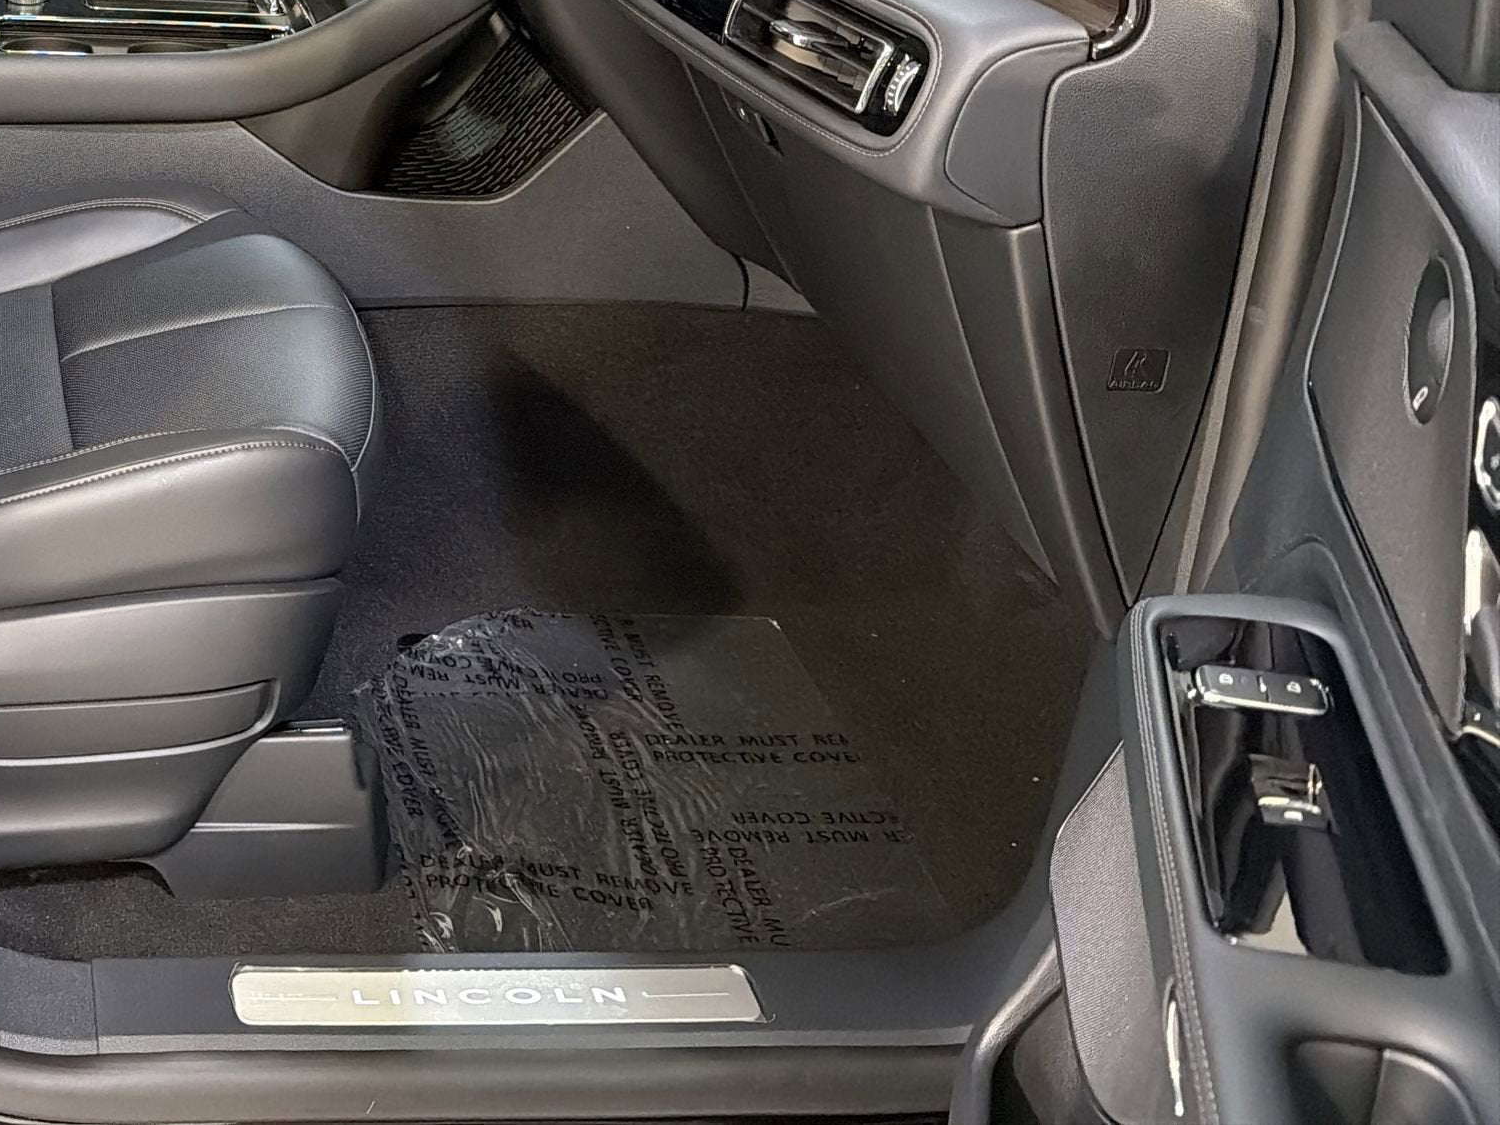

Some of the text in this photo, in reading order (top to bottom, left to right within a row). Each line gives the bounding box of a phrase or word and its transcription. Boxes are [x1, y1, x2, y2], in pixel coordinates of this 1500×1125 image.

[644, 675, 684, 731] REMOVE
[644, 733, 725, 747] DEALER
[738, 733, 799, 747] MUST
[652, 750, 861, 764] PROTECTIVE COVE
[730, 810, 812, 825] COVER
[690, 828, 791, 844] REMOVE
[804, 829, 870, 844] MUST
[596, 872, 696, 897] REMOVE
[727, 847, 773, 907] DEALER
[571, 885, 655, 911] COVER
[699, 847, 760, 944] PROTECTIVE
[351, 986, 628, 1006] LINCOLN
